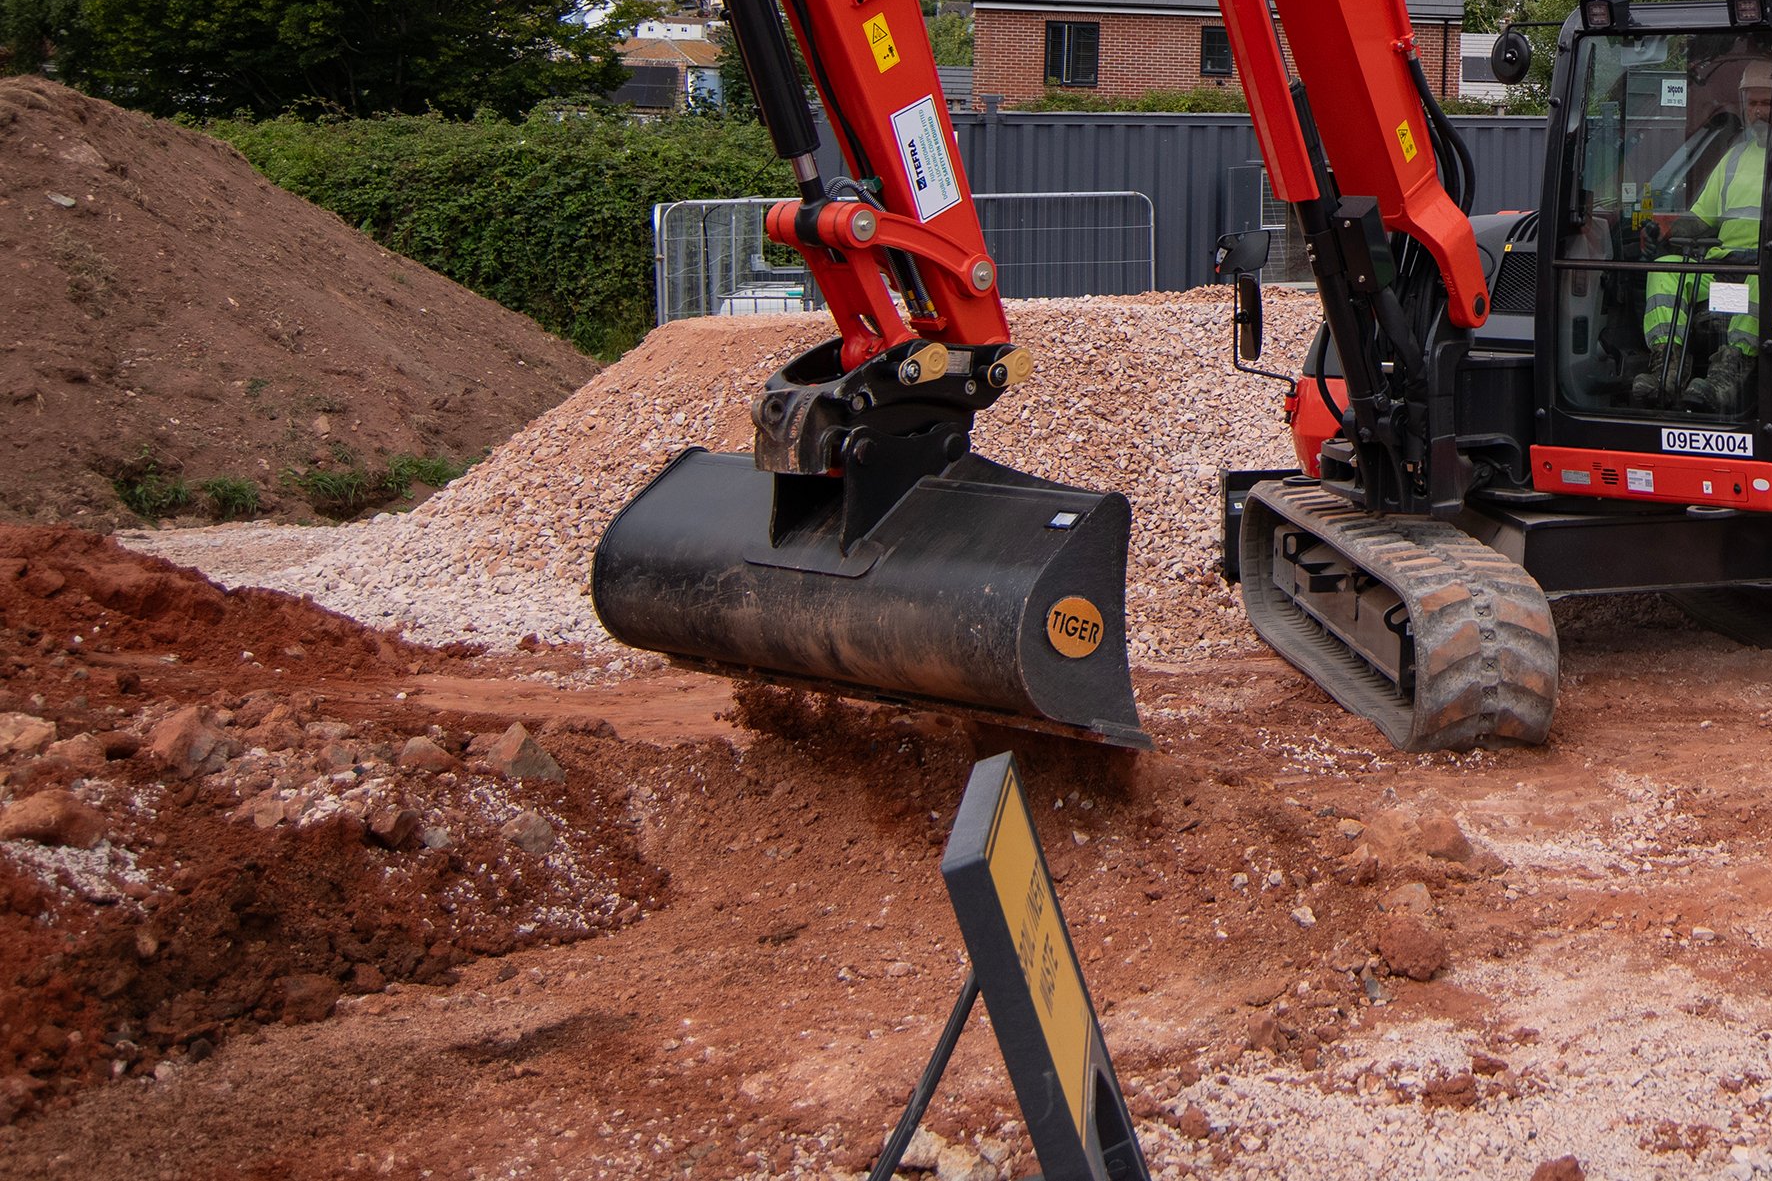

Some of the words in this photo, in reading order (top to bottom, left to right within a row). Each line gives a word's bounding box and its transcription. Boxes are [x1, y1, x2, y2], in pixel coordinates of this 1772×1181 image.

[919, 109, 927, 126] FITTED
[924, 126, 934, 152] COUPLER
[927, 116, 939, 144] REQUIRED
[908, 138, 923, 177] TEFRA
[918, 134, 930, 165] AUTOMATIC
[927, 165, 935, 182] FULLY
[931, 152, 941, 177] LOCKING
[939, 155, 948, 176] SAFETY
[938, 177, 948, 200] DOUBLE
[945, 176, 951, 186] NO
[1667, 431, 1748, 453] 09EX004
[1053, 611, 1100, 644] TIGER
